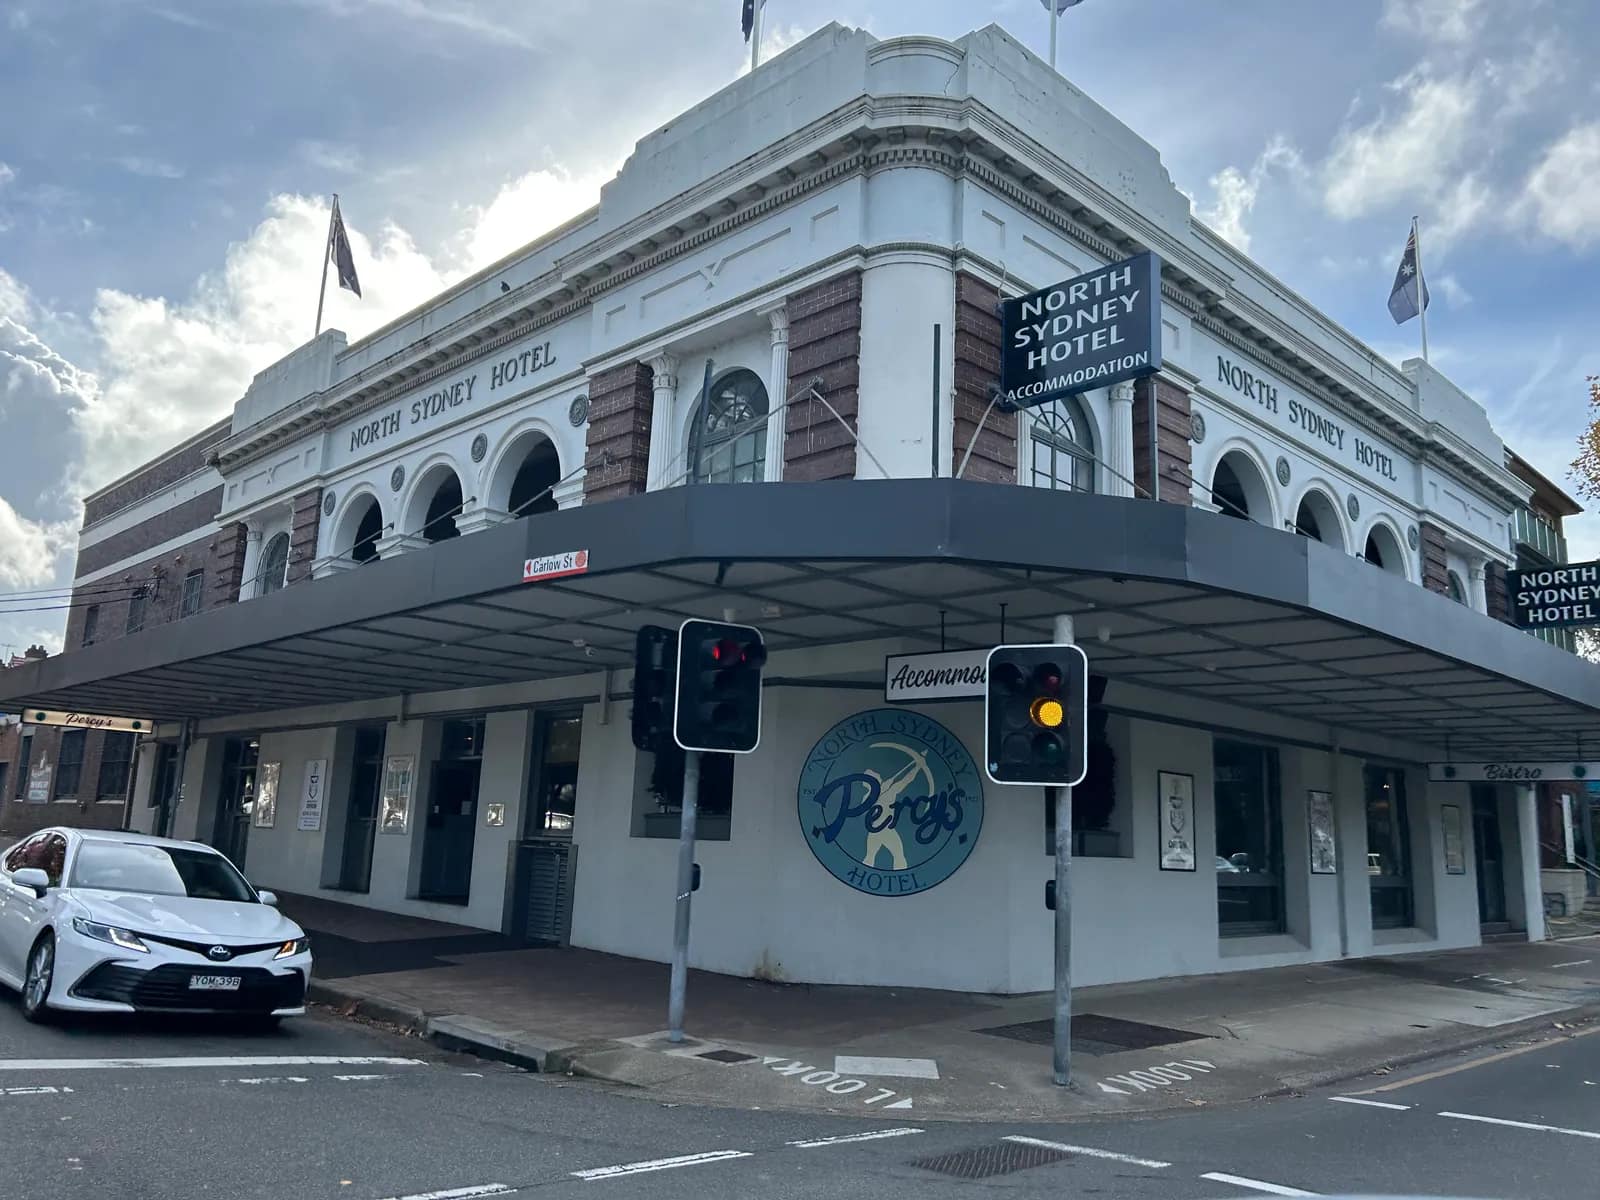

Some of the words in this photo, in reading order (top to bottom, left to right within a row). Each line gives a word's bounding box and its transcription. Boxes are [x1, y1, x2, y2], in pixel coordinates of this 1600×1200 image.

[1022, 266, 1131, 321] NORTH
[1014, 290, 1140, 348] SYDNEY
[1027, 325, 1125, 370] HOTEL
[350, 410, 401, 452] NORTH
[410, 375, 477, 425] SYDNEY
[490, 342, 556, 391] HOTEL
[1005, 351, 1148, 403] ACCOMMODATION
[1217, 355, 1279, 414] NORTH
[1288, 400, 1346, 450] SYDNEY
[1354, 438, 1397, 482] HOTEL
[533, 559, 560, 574] Carlow
[563, 555, 573, 569] St
[1520, 567, 1597, 588] NORTH
[1517, 585, 1600, 606] SYDNEY
[1528, 604, 1597, 623] HOTEL
[65, 712, 114, 728] Percy's
[808, 715, 877, 773] NORTH
[890, 715, 973, 777] SYDNEY
[1483, 764, 1542, 780] Bistro
[812, 773, 966, 845] Percy's
[847, 867, 928, 892] HOTEL
[771, 1061, 897, 1104] LOOK
[1105, 1061, 1210, 1092] LOOK
